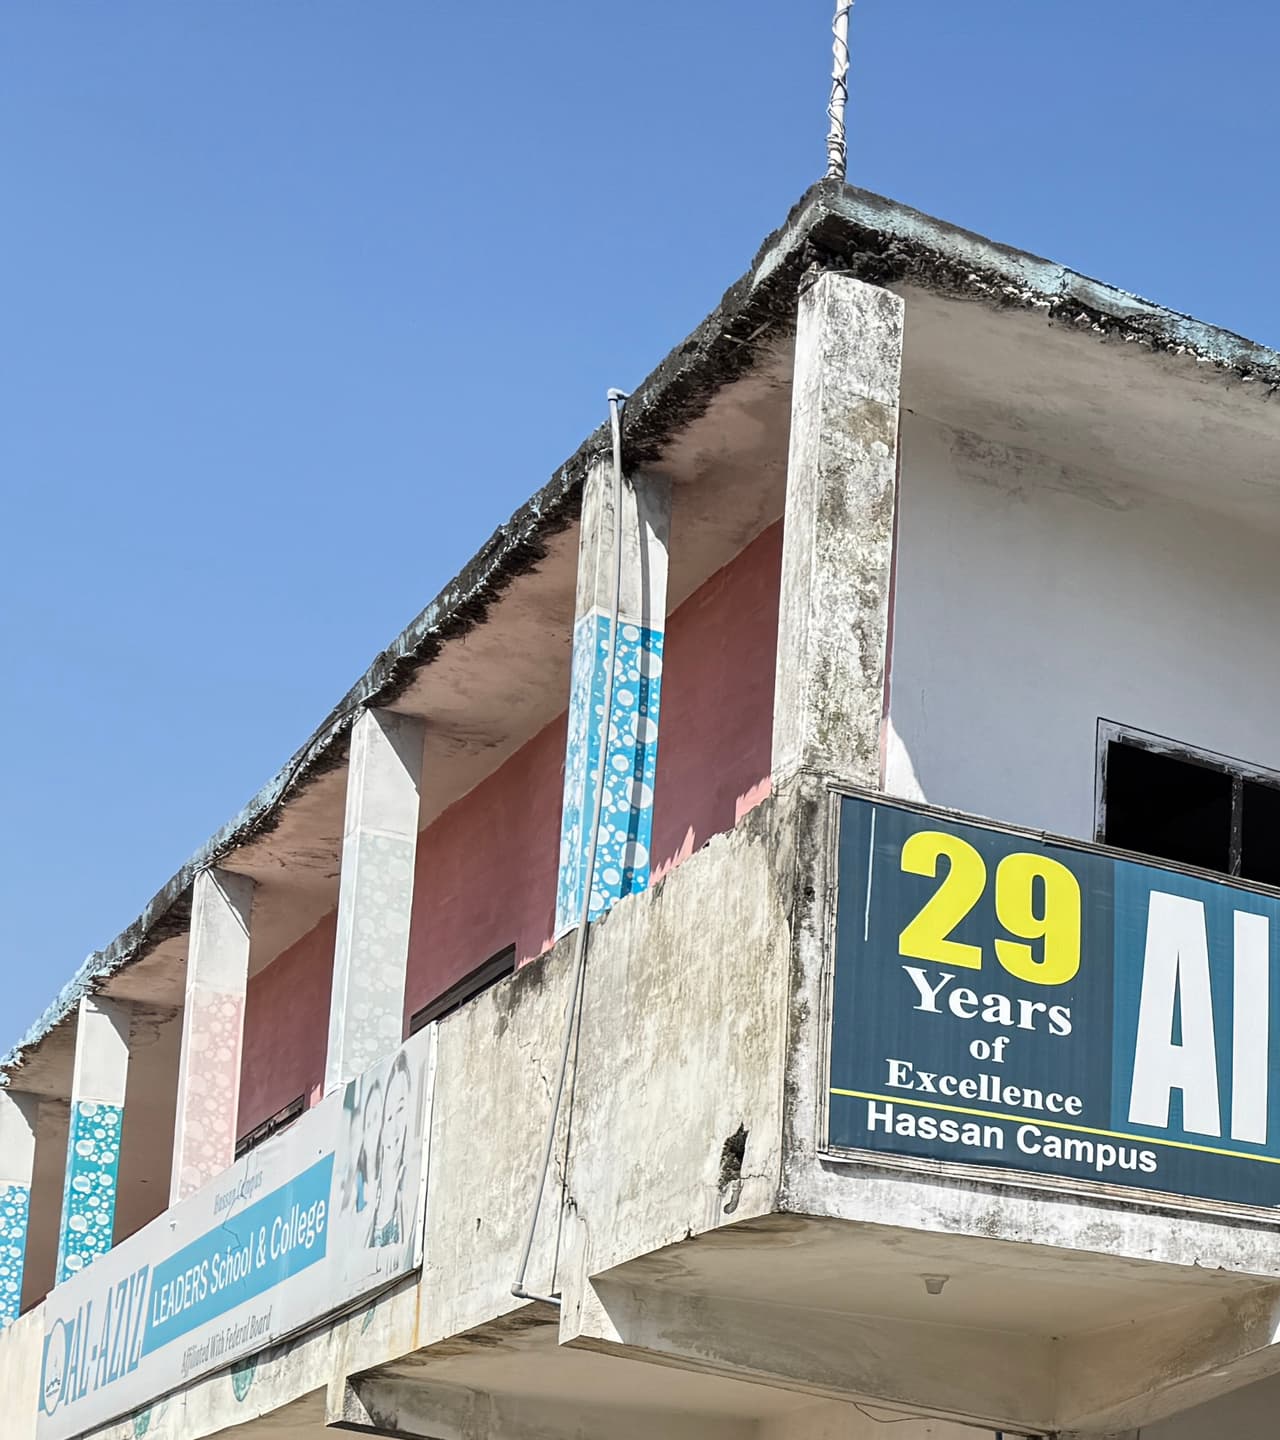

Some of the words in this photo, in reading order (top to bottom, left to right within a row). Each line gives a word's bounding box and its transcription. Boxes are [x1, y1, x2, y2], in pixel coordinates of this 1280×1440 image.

[899, 831, 1081, 985] 29
[902, 965, 1073, 1036] Years
[970, 1036, 1010, 1063] of
[885, 1058, 1083, 1116] Excellence
[867, 1100, 1004, 1150] Hassan
[1016, 1124, 1158, 1172] Campus
[65, 1264, 149, 1406] AL-AZIZ
[152, 1261, 209, 1328] LEADERS
[210, 1238, 254, 1295] School
[255, 1227, 267, 1268] &
[270, 1200, 326, 1262] College
